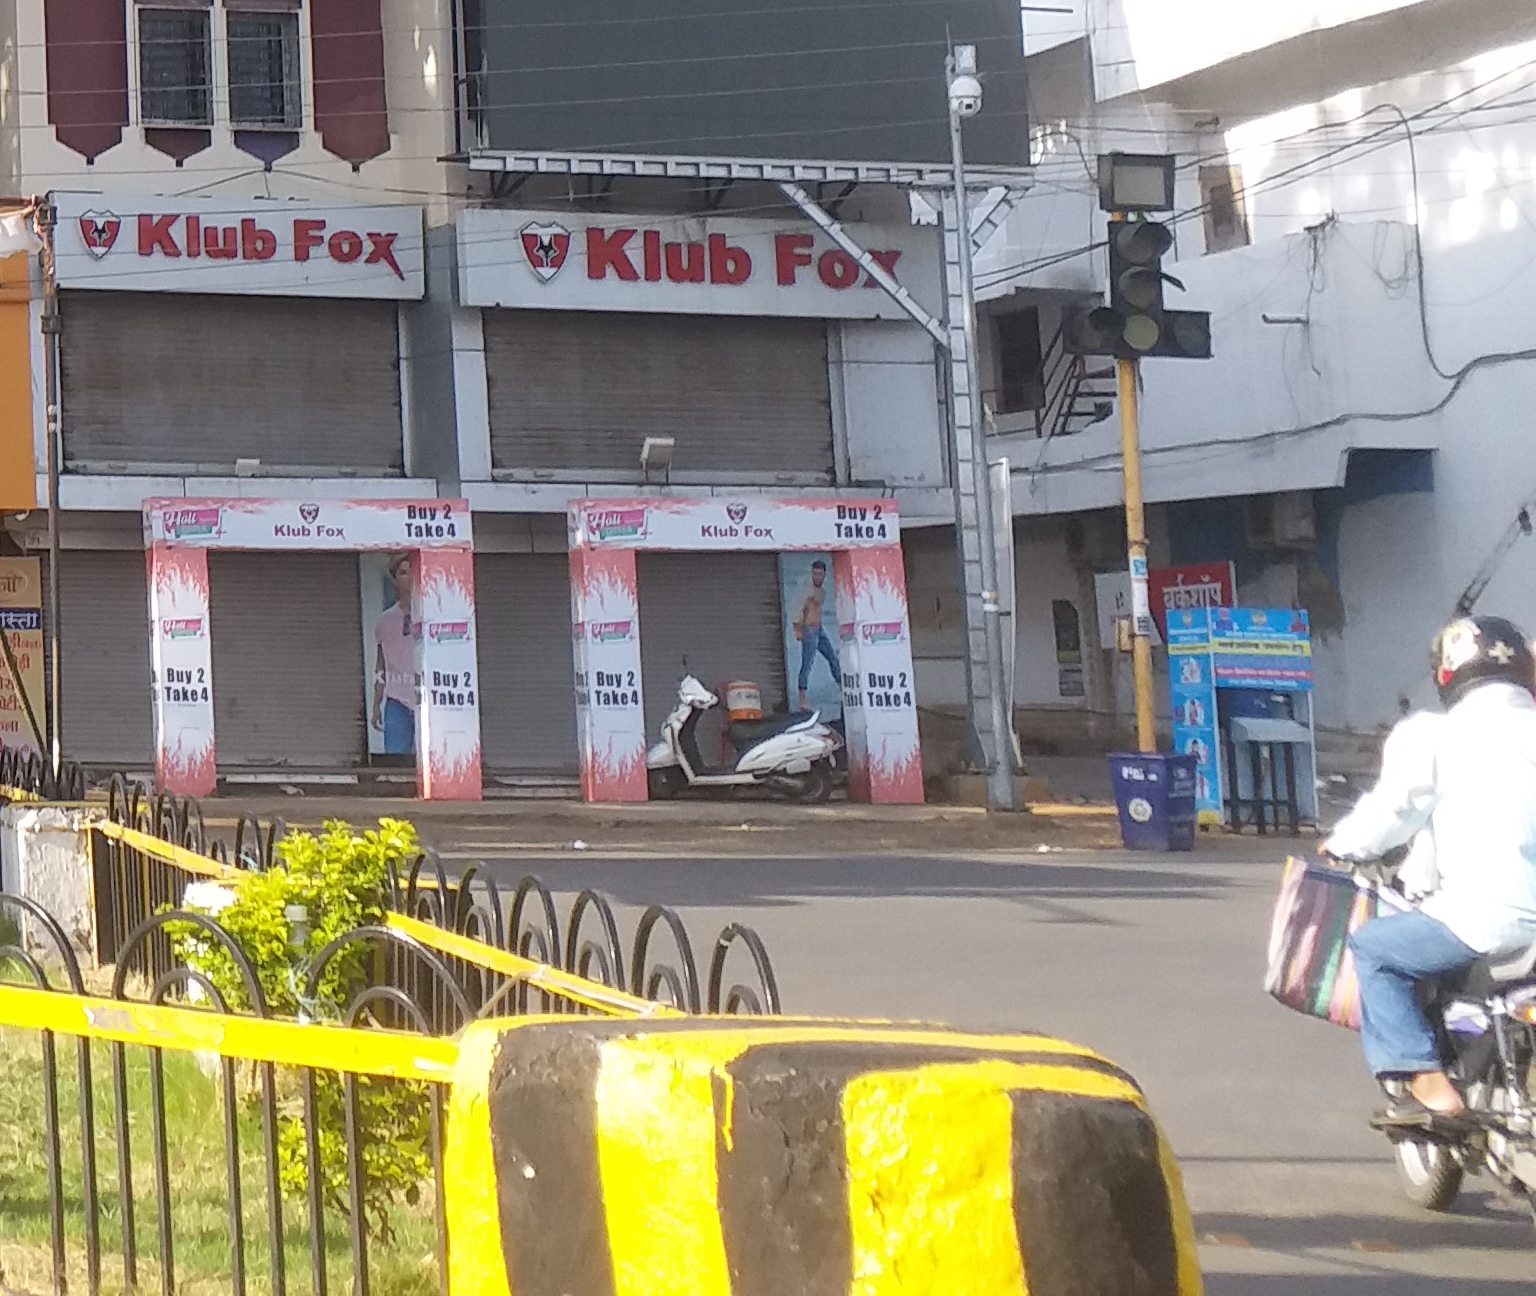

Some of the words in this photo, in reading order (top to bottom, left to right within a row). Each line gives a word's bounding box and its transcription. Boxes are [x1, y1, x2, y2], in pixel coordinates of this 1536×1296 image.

[137, 213, 277, 261] Klub
[293, 218, 405, 281] Fox
[586, 227, 753, 286] Klub
[774, 233, 903, 291] Fox
[407, 505, 438, 522] Buy
[442, 504, 452, 520] 2
[837, 504, 867, 522] Buy
[873, 504, 883, 520] 2
[274, 524, 311, 538] Klub
[316, 525, 345, 540] Fox
[404, 522, 444, 538] Take
[446, 522, 457, 539] 4
[701, 525, 739, 538] Klub
[744, 525, 774, 541] Fox
[834, 522, 875, 539] Take
[877, 522, 888, 540] 4
[166, 667, 192, 685] Buy
[197, 667, 205, 683] 2
[433, 671, 459, 688] Buy
[463, 671, 471, 687] 2
[596, 671, 622, 688] Buy
[626, 670, 635, 687] 2
[868, 672, 894, 689] Buy
[898, 672, 907, 688] 2
[164, 686, 198, 702] Take
[200, 686, 208, 703] 4
[431, 689, 465, 706] Take
[467, 690, 475, 706] 4
[594, 689, 629, 706] Take
[630, 689, 639, 706] 4
[867, 691, 901, 707] Take
[903, 691, 912, 707] 4
